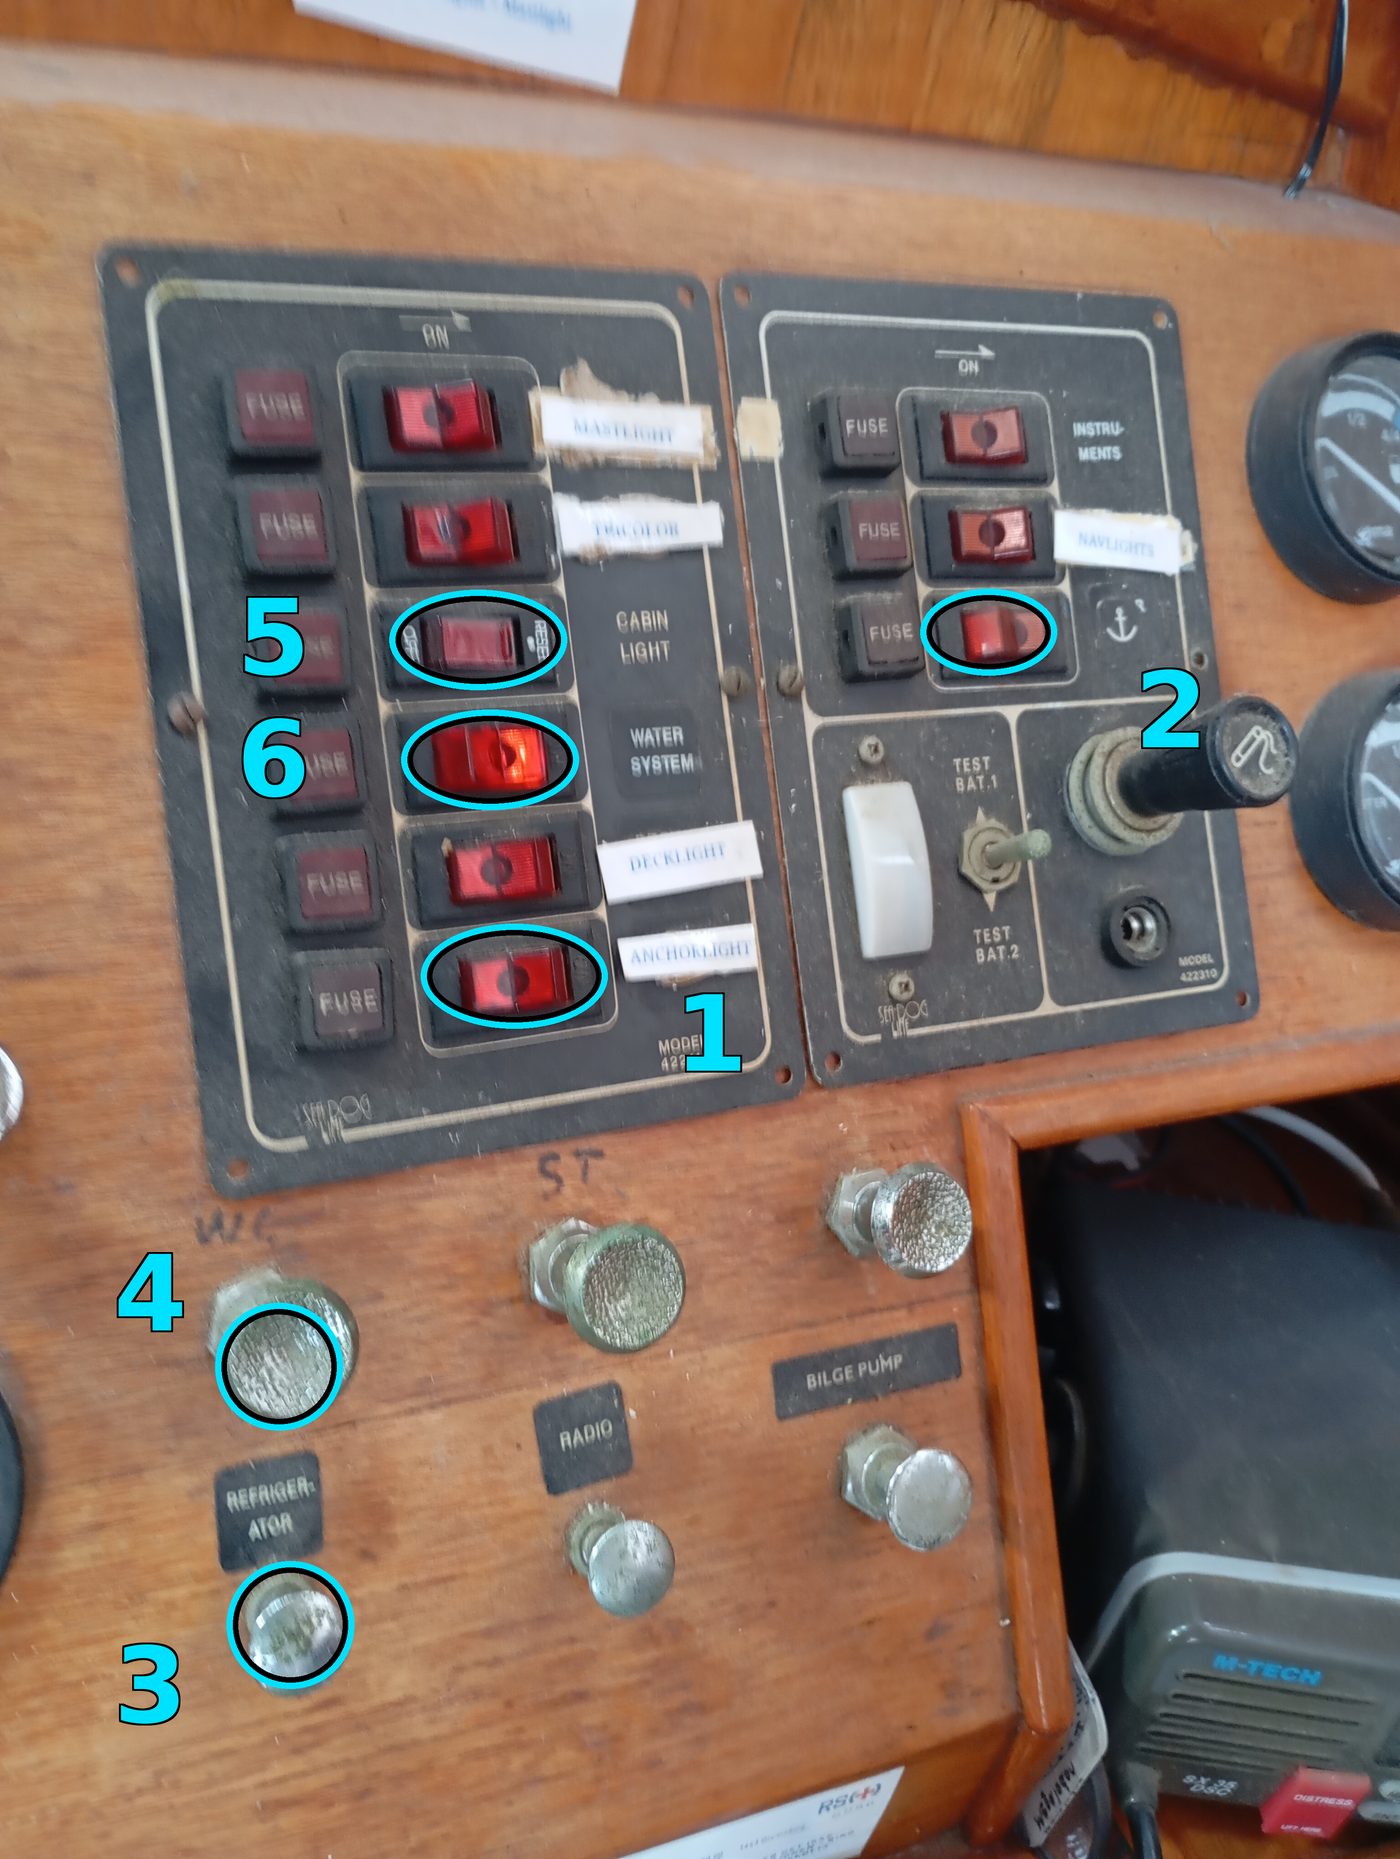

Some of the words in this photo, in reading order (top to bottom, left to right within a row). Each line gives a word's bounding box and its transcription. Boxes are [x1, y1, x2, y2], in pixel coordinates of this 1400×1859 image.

[422, 323, 449, 349] ON
[958, 358, 980, 376] ON
[245, 391, 306, 422] FUSE
[846, 416, 889, 438] FUSE
[1078, 445, 1122, 462] MENTS
[259, 511, 319, 542] FUSE
[859, 521, 901, 541] FUSE
[1078, 531, 1156, 559] NAVLIGHTS
[615, 609, 670, 634] CABIN
[869, 621, 914, 643] FUSE
[620, 640, 671, 665] LIGHT
[629, 725, 685, 750] WATER
[630, 752, 695, 777] SYSTEM
[953, 755, 991, 774] TEST
[629, 840, 726, 873] DECKLIGHT
[306, 869, 366, 900] FUSE
[973, 925, 1011, 946] TEST
[631, 940, 752, 965] ANCHORLIGHT
[1178, 952, 1215, 968] MODEL
[318, 987, 379, 1018] FUSE
[806, 1364, 855, 1391] BILGE
[857, 1351, 904, 1379] PUMP
[559, 1418, 614, 1453] RADIO
[247, 1511, 295, 1543] ATOR
[1212, 1652, 1324, 1687] M-TECH
[1189, 1783, 1233, 1797] DSC
[1294, 1793, 1355, 1808] DISTRESS
